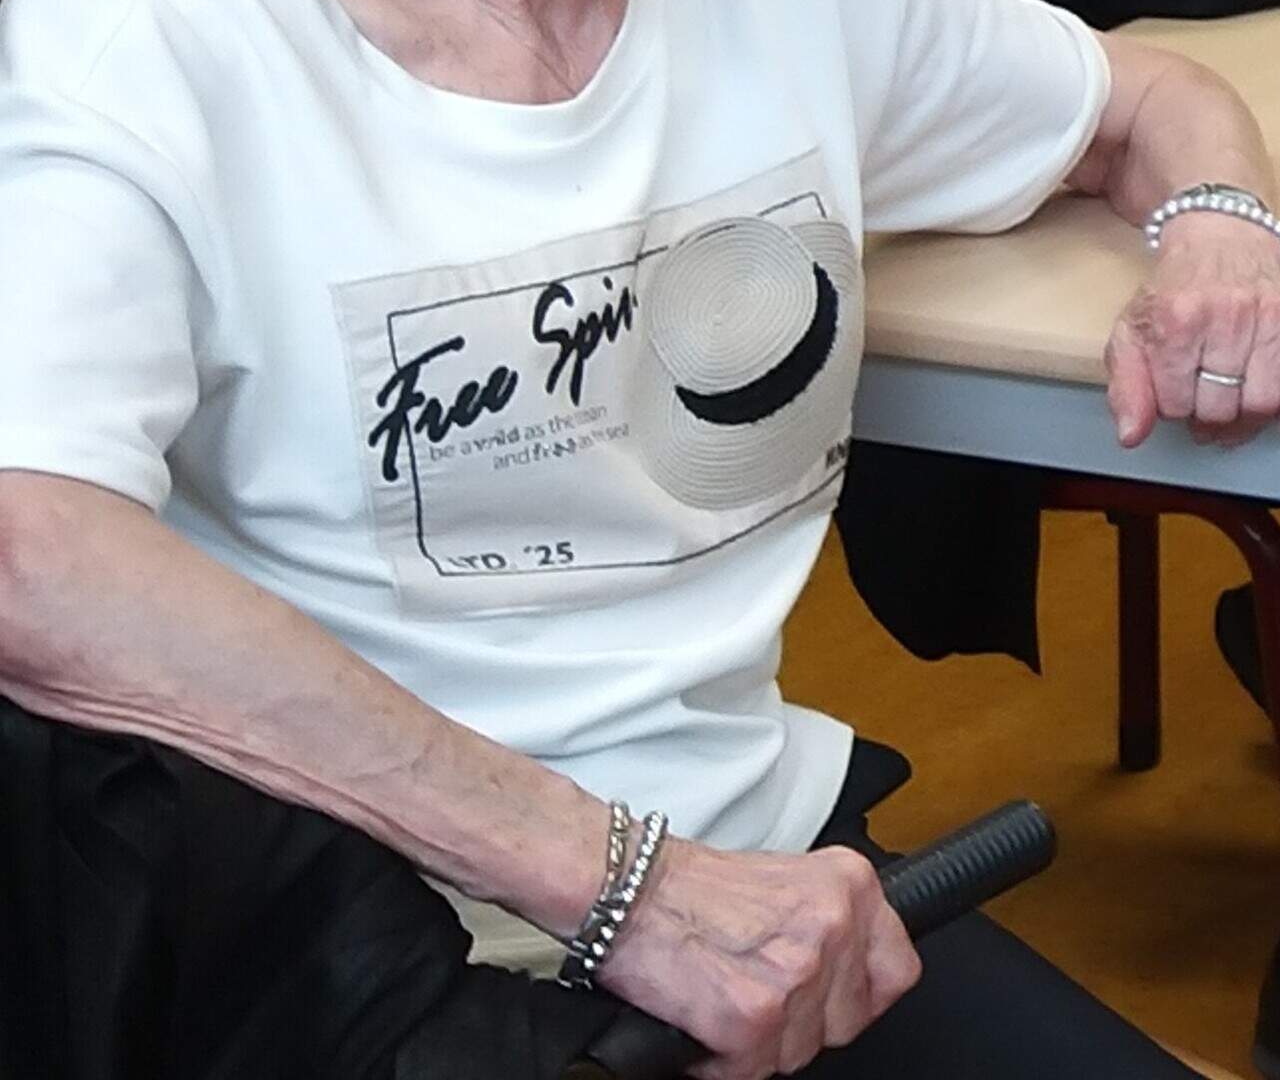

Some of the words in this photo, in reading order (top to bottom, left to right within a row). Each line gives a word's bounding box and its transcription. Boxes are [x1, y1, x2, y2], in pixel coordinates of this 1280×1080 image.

[369, 336, 517, 481] Free
[533, 274, 639, 407] Spir
[492, 448, 531, 470] and
